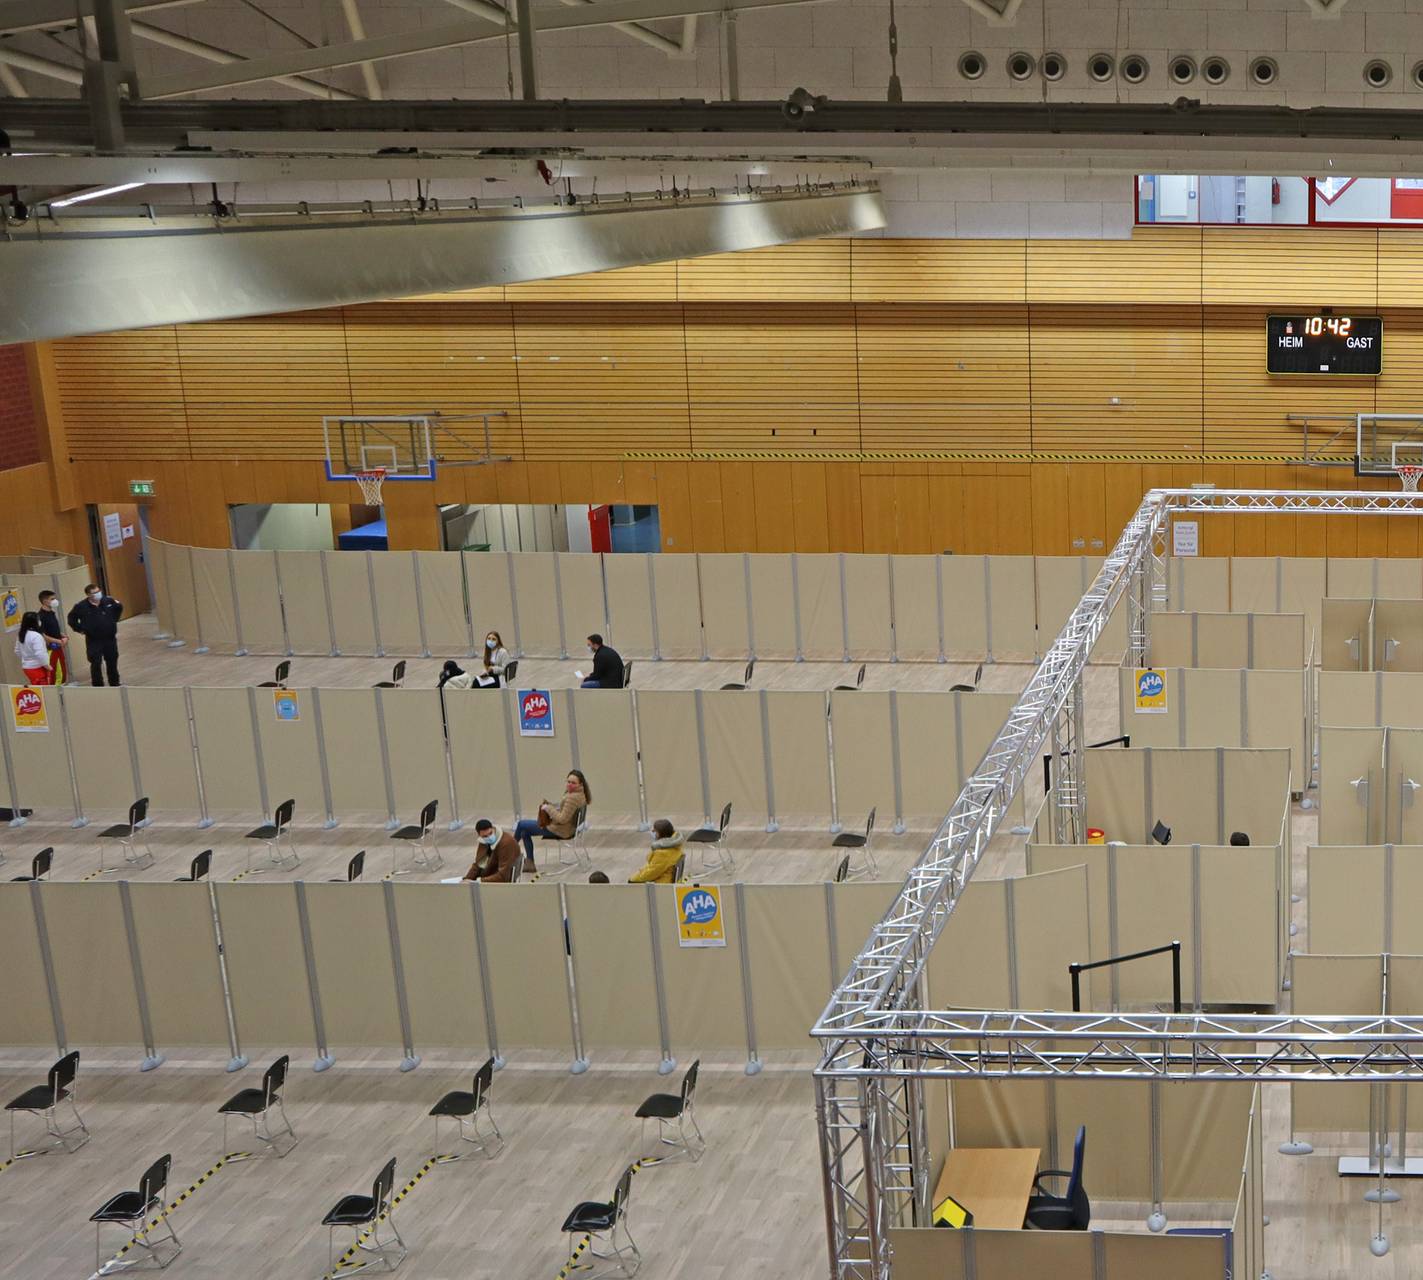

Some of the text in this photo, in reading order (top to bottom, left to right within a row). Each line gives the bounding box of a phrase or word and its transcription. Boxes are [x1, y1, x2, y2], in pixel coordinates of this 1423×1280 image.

[1305, 317, 1351, 335] 10:42
[1278, 336, 1303, 348] HEIM
[1346, 337, 1374, 348] GAST
[1140, 675, 1163, 691] AHA
[18, 693, 41, 708] AHA
[524, 696, 548, 713] AHA
[685, 894, 716, 916] AHA
